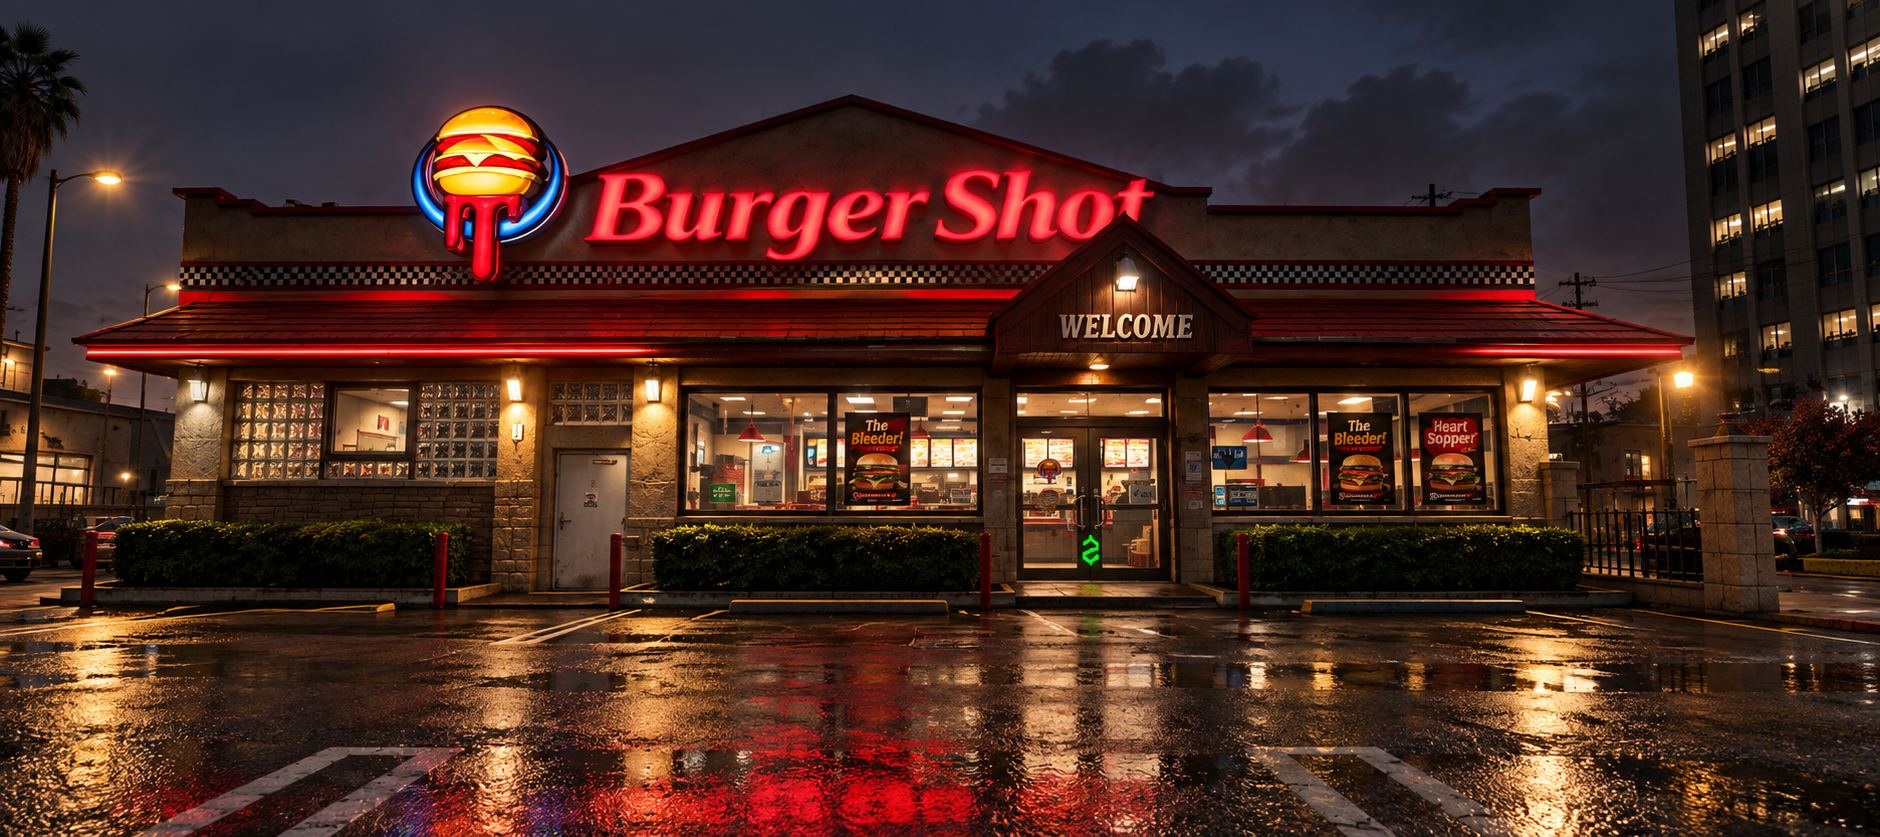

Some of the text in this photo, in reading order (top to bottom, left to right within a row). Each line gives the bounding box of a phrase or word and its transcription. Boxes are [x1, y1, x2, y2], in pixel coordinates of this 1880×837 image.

[585, 169, 1155, 261] Burger Shot
[1058, 313, 1194, 340] WELCOME
[865, 418, 889, 432] The
[1347, 419, 1371, 432] The
[1434, 420, 1468, 433] Heart
[851, 431, 904, 446] Bleeder!
[1334, 431, 1387, 446] Bleeder!
